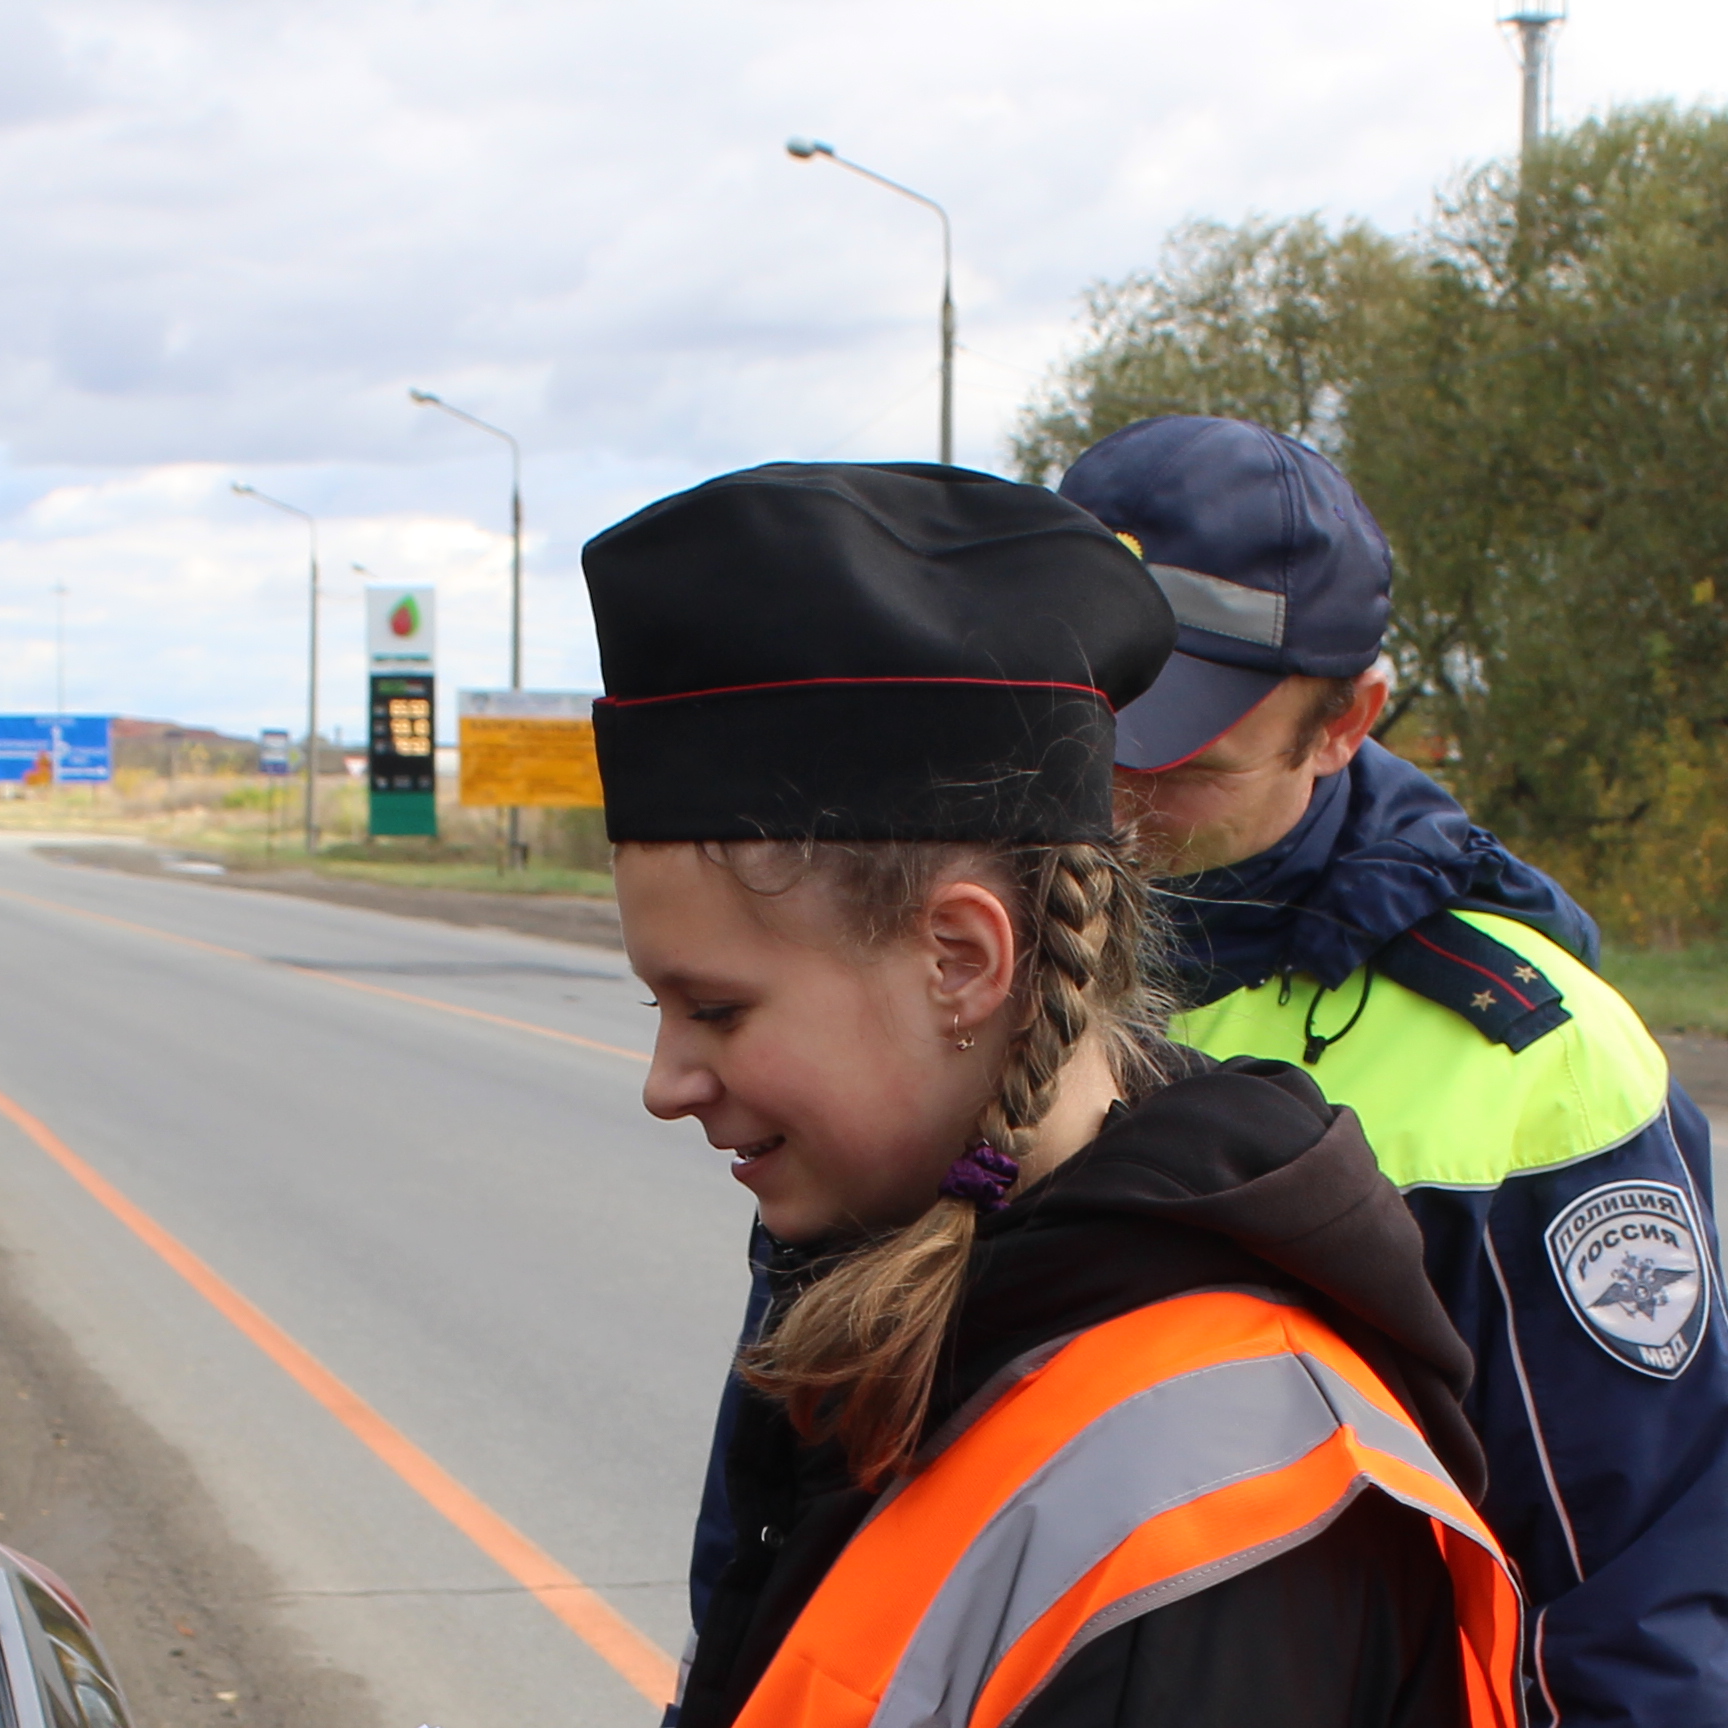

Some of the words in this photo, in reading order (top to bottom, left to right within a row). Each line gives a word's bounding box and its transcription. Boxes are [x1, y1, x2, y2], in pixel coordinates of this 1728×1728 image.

[1558, 1193, 1680, 1255] ПОЛИЦИЯ
[1577, 1223, 1680, 1282] РОССИЯ
[1638, 1333, 1689, 1371] МВД
